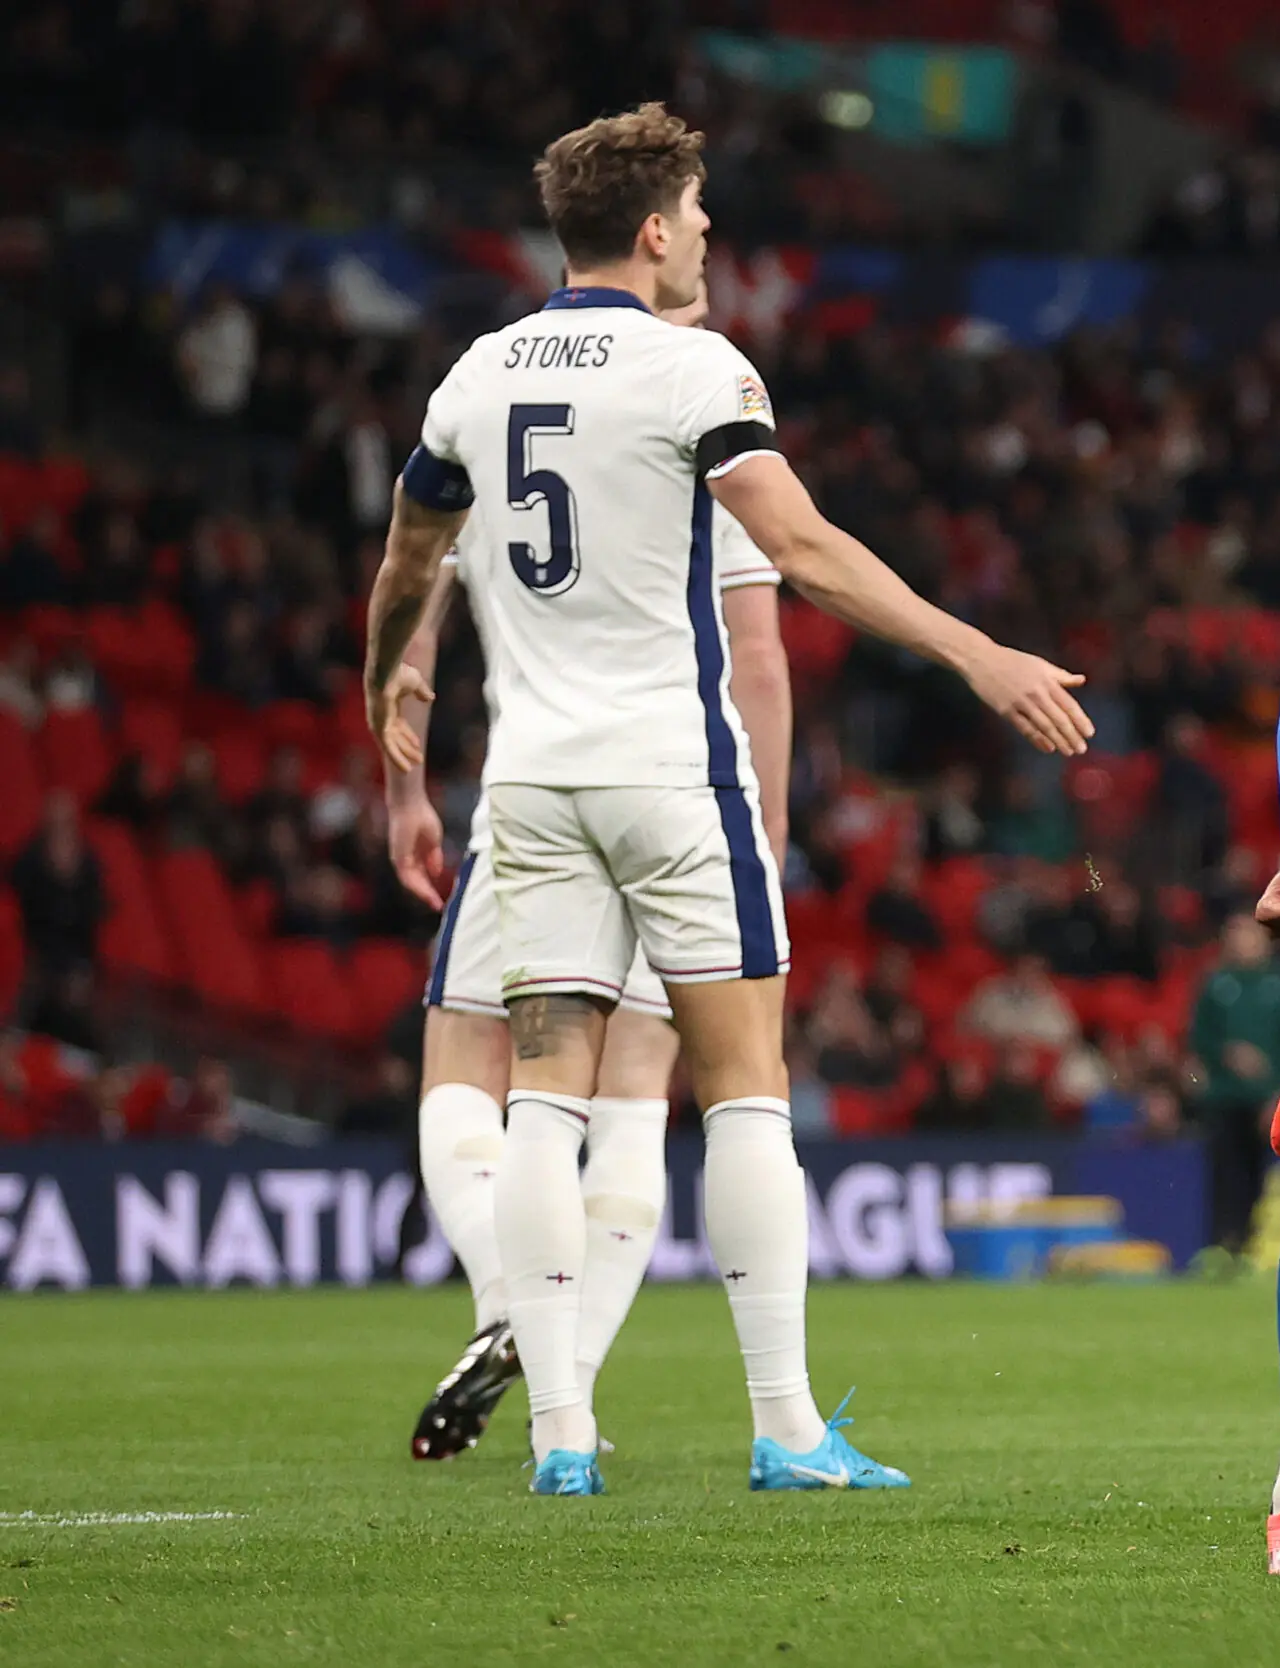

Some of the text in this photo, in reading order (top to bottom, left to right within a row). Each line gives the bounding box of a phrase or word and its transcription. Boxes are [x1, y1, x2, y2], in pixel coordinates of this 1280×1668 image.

[504, 334, 614, 369] STONES
[507, 402, 581, 597] 5
[113, 1168, 458, 1289] NATIO
